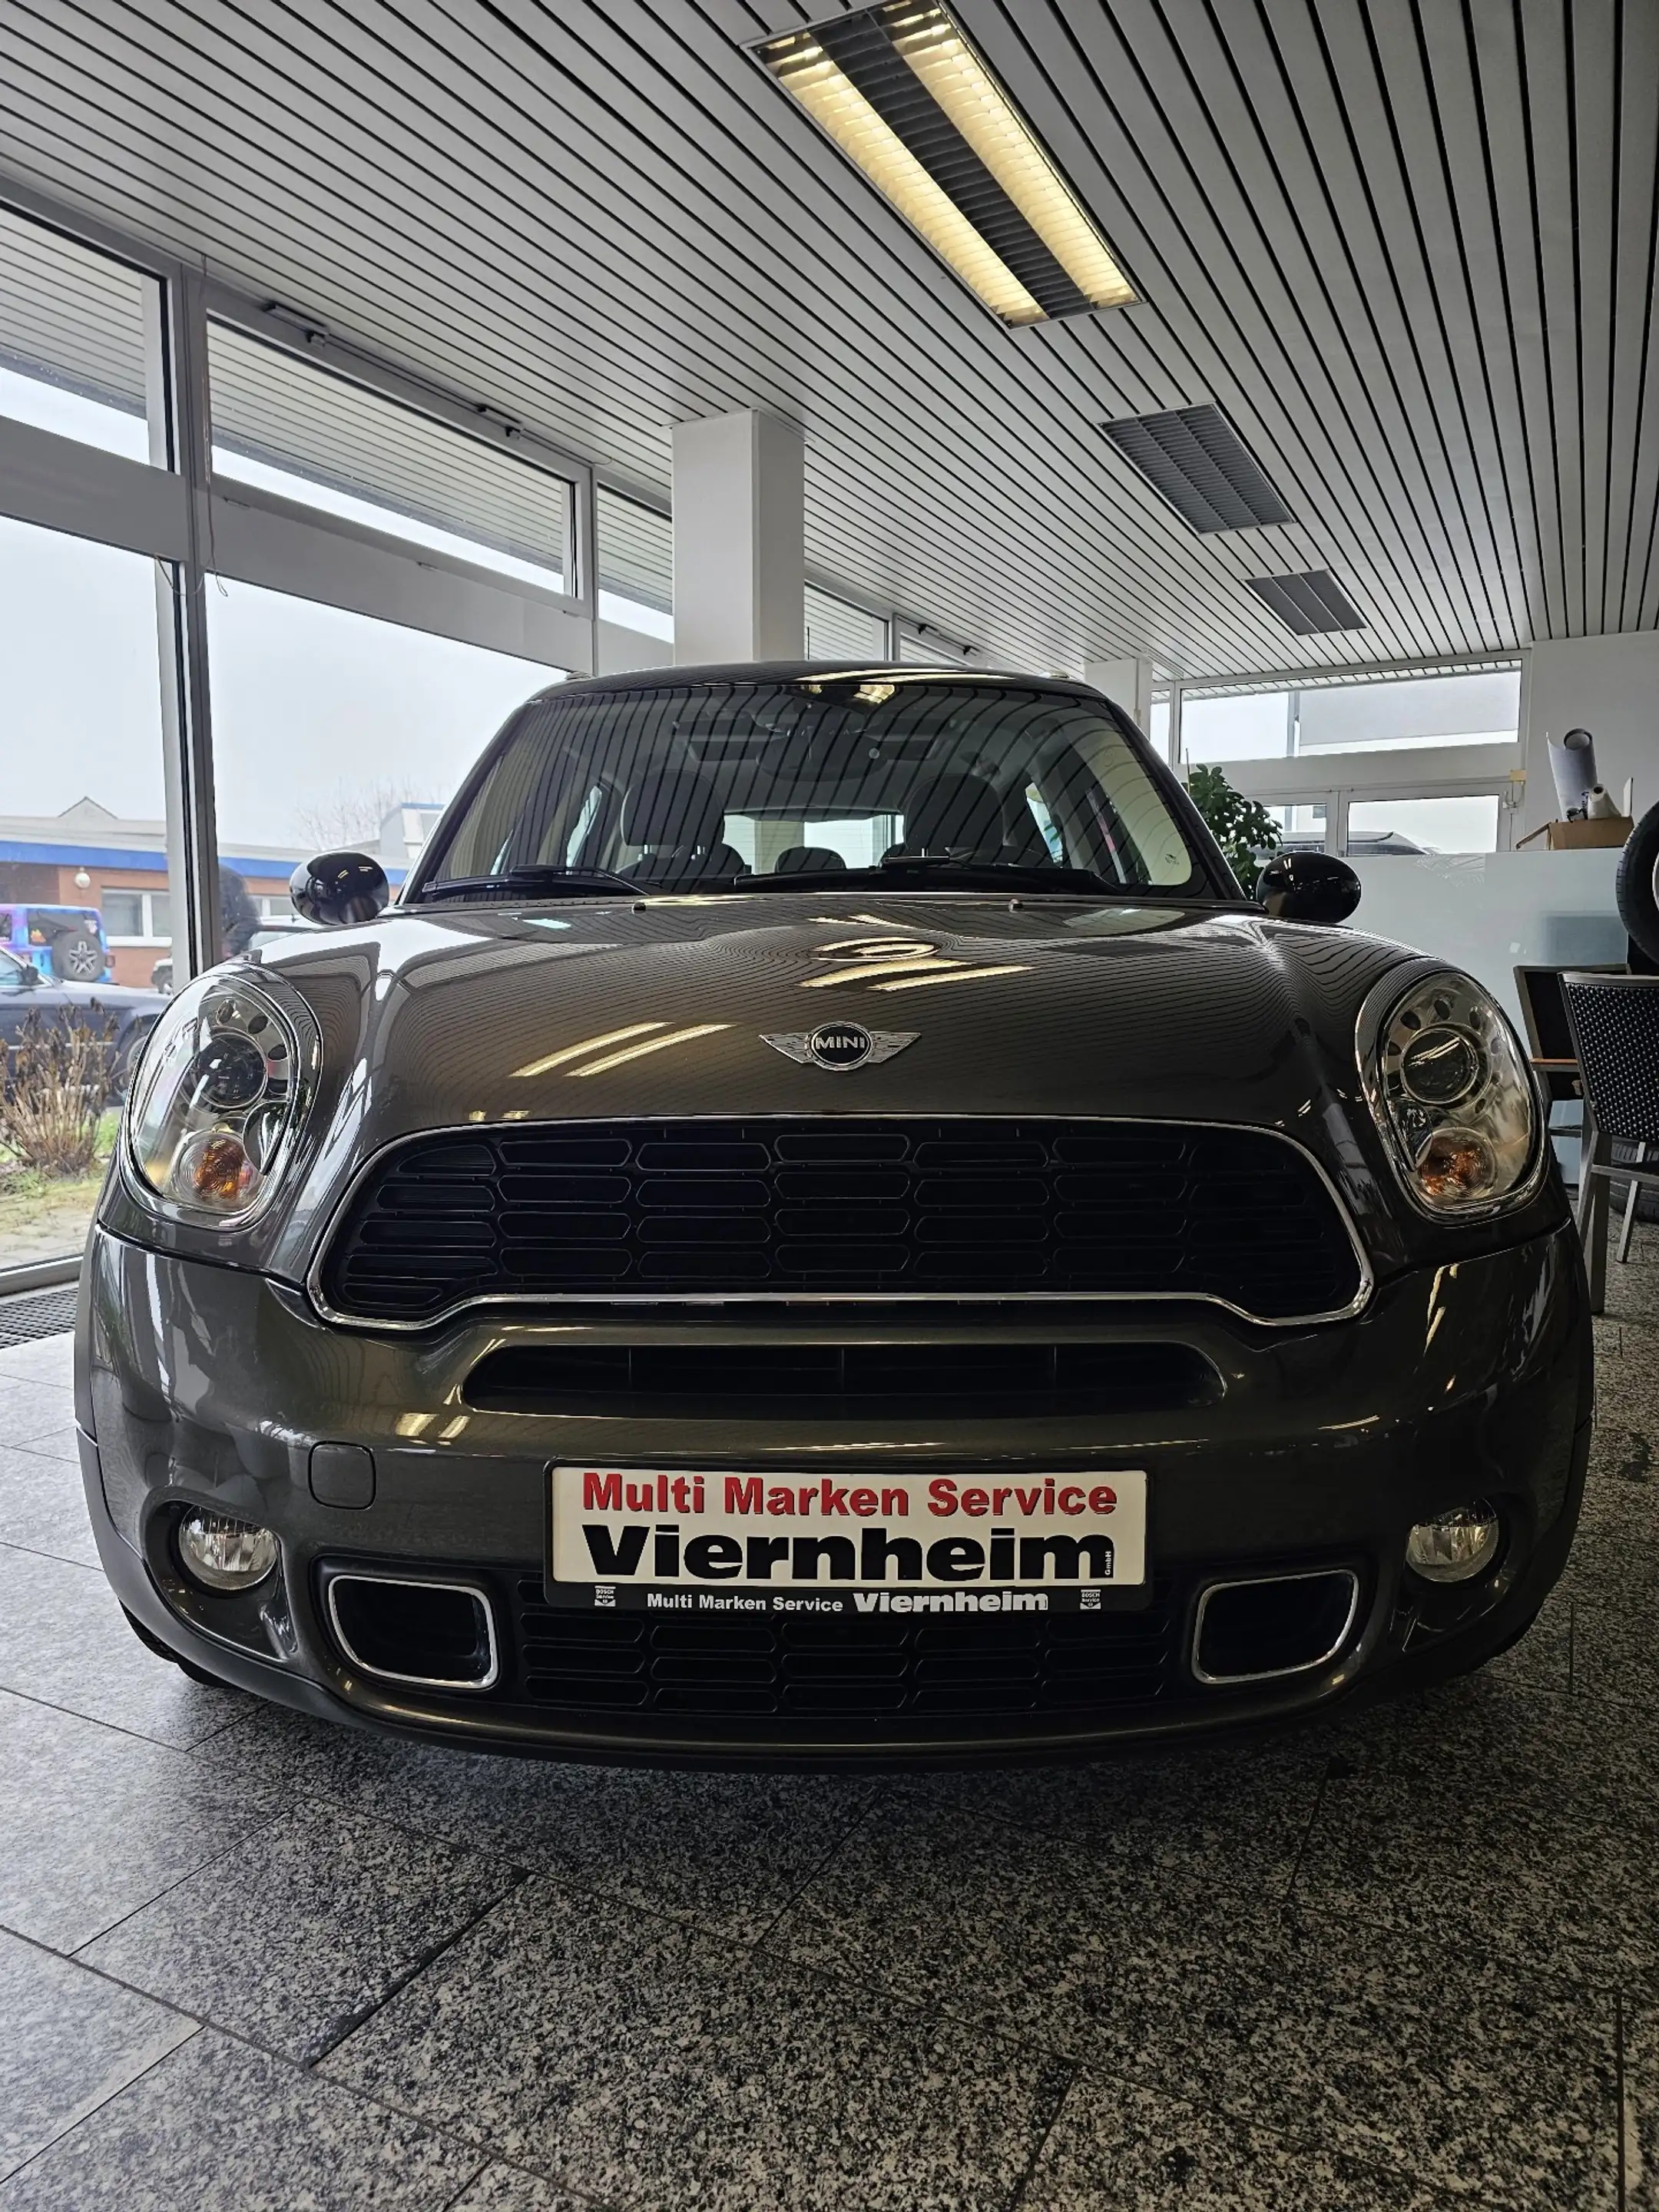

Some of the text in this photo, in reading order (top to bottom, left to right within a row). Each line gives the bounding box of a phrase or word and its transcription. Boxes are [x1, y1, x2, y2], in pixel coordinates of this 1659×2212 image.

[815, 1035, 866, 1050] MINI
[583, 1472, 1118, 1518] Multi Marken Service
[581, 1524, 1114, 1581] Viernheim
[647, 1591, 1048, 1612] Multi Marken Service Viernheim
